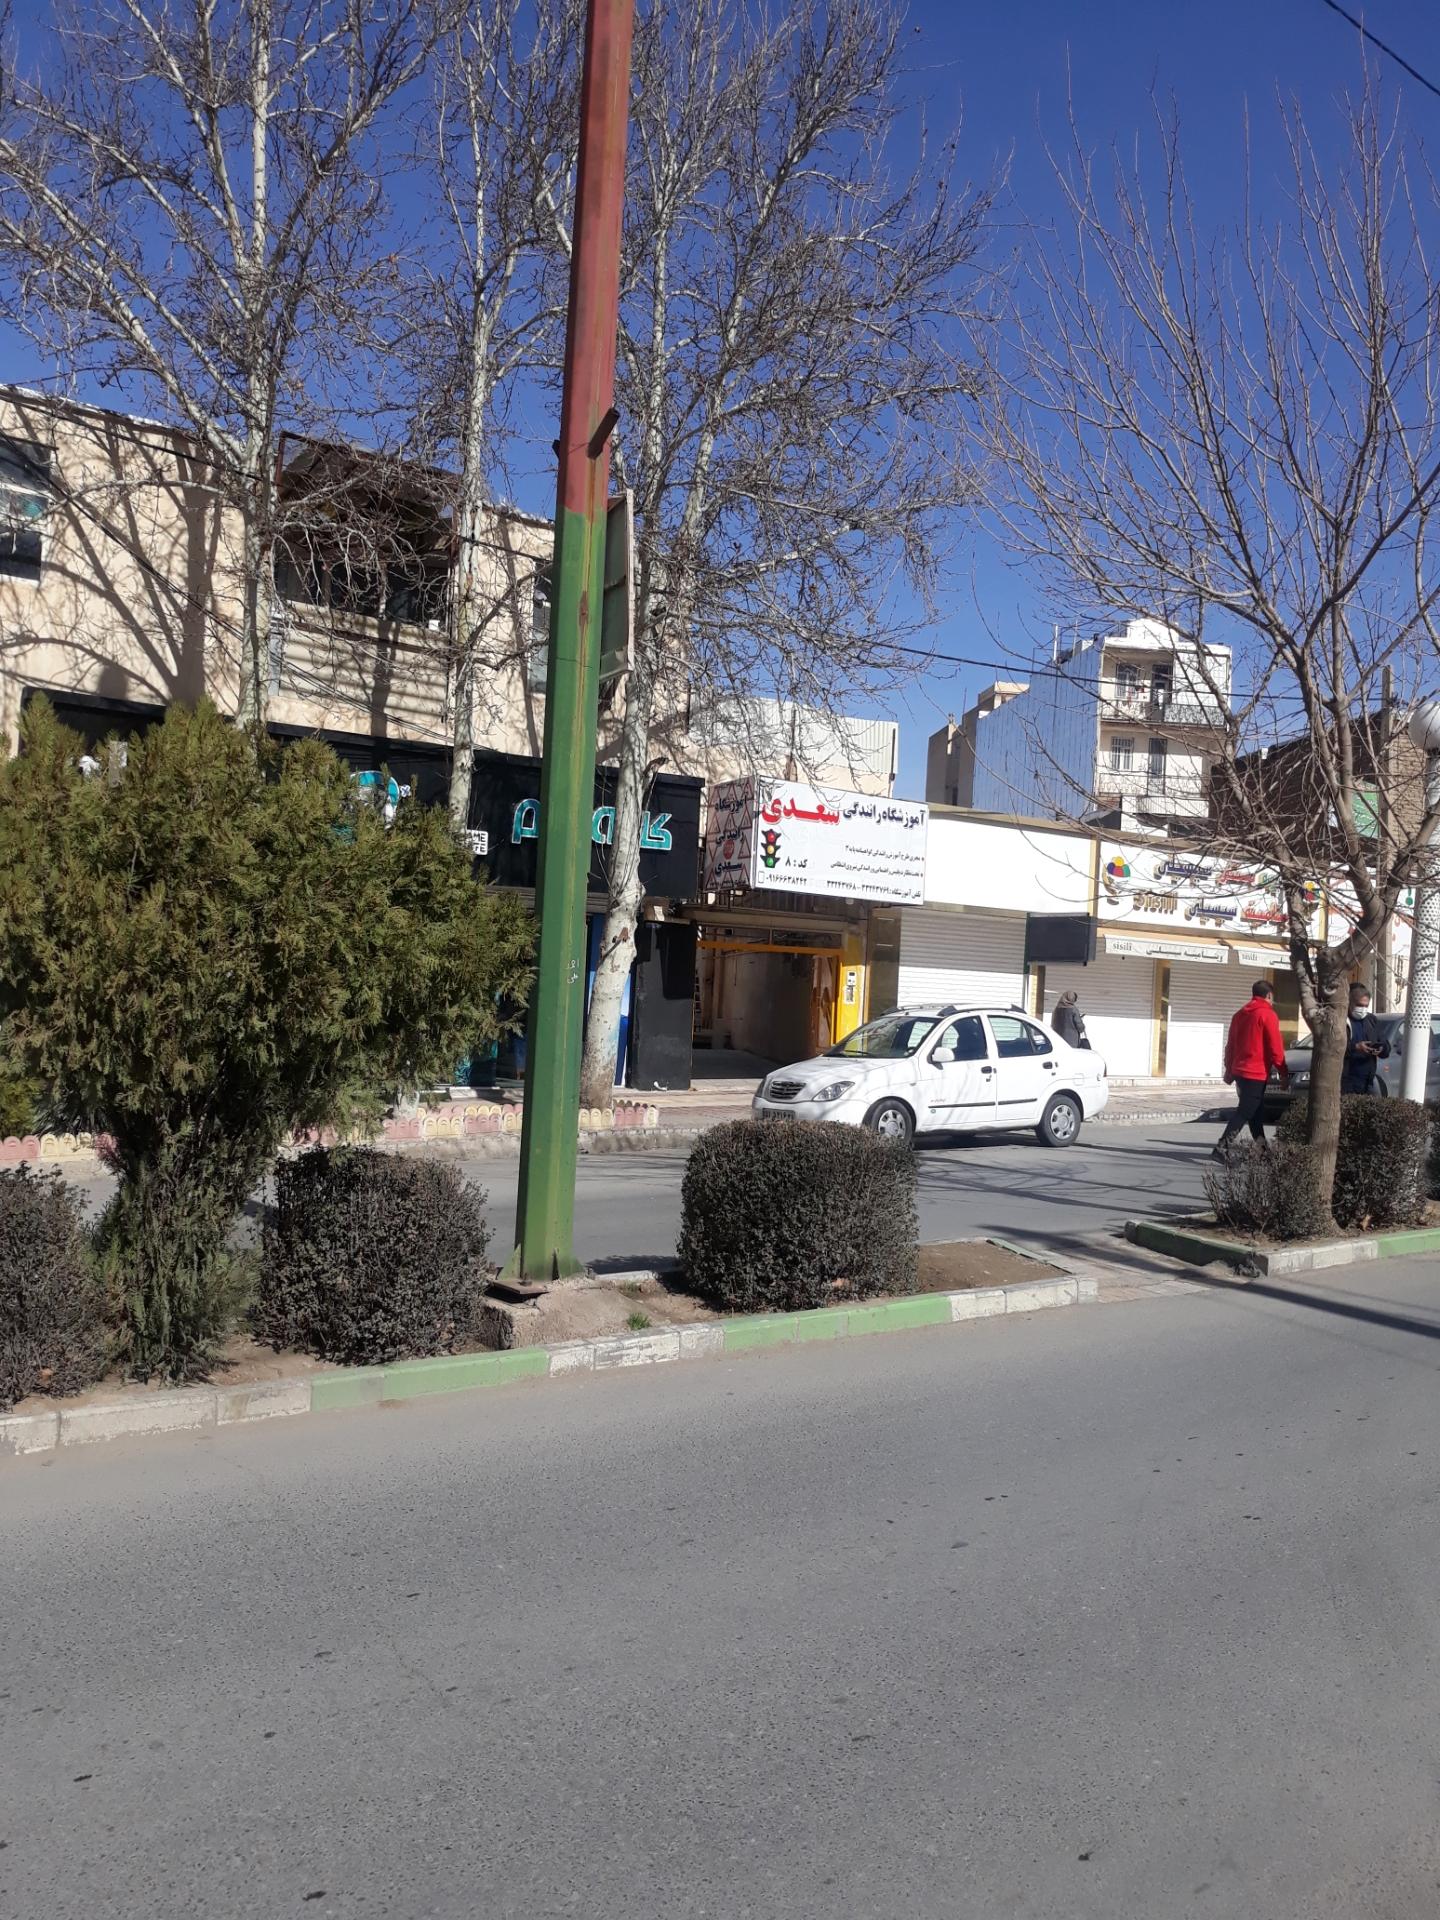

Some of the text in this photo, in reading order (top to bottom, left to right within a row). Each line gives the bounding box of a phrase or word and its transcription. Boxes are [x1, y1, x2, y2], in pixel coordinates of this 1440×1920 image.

[761, 798, 926, 829] آموزشگاه رانندگی سعدی
[1112, 941, 1132, 952] sisili
